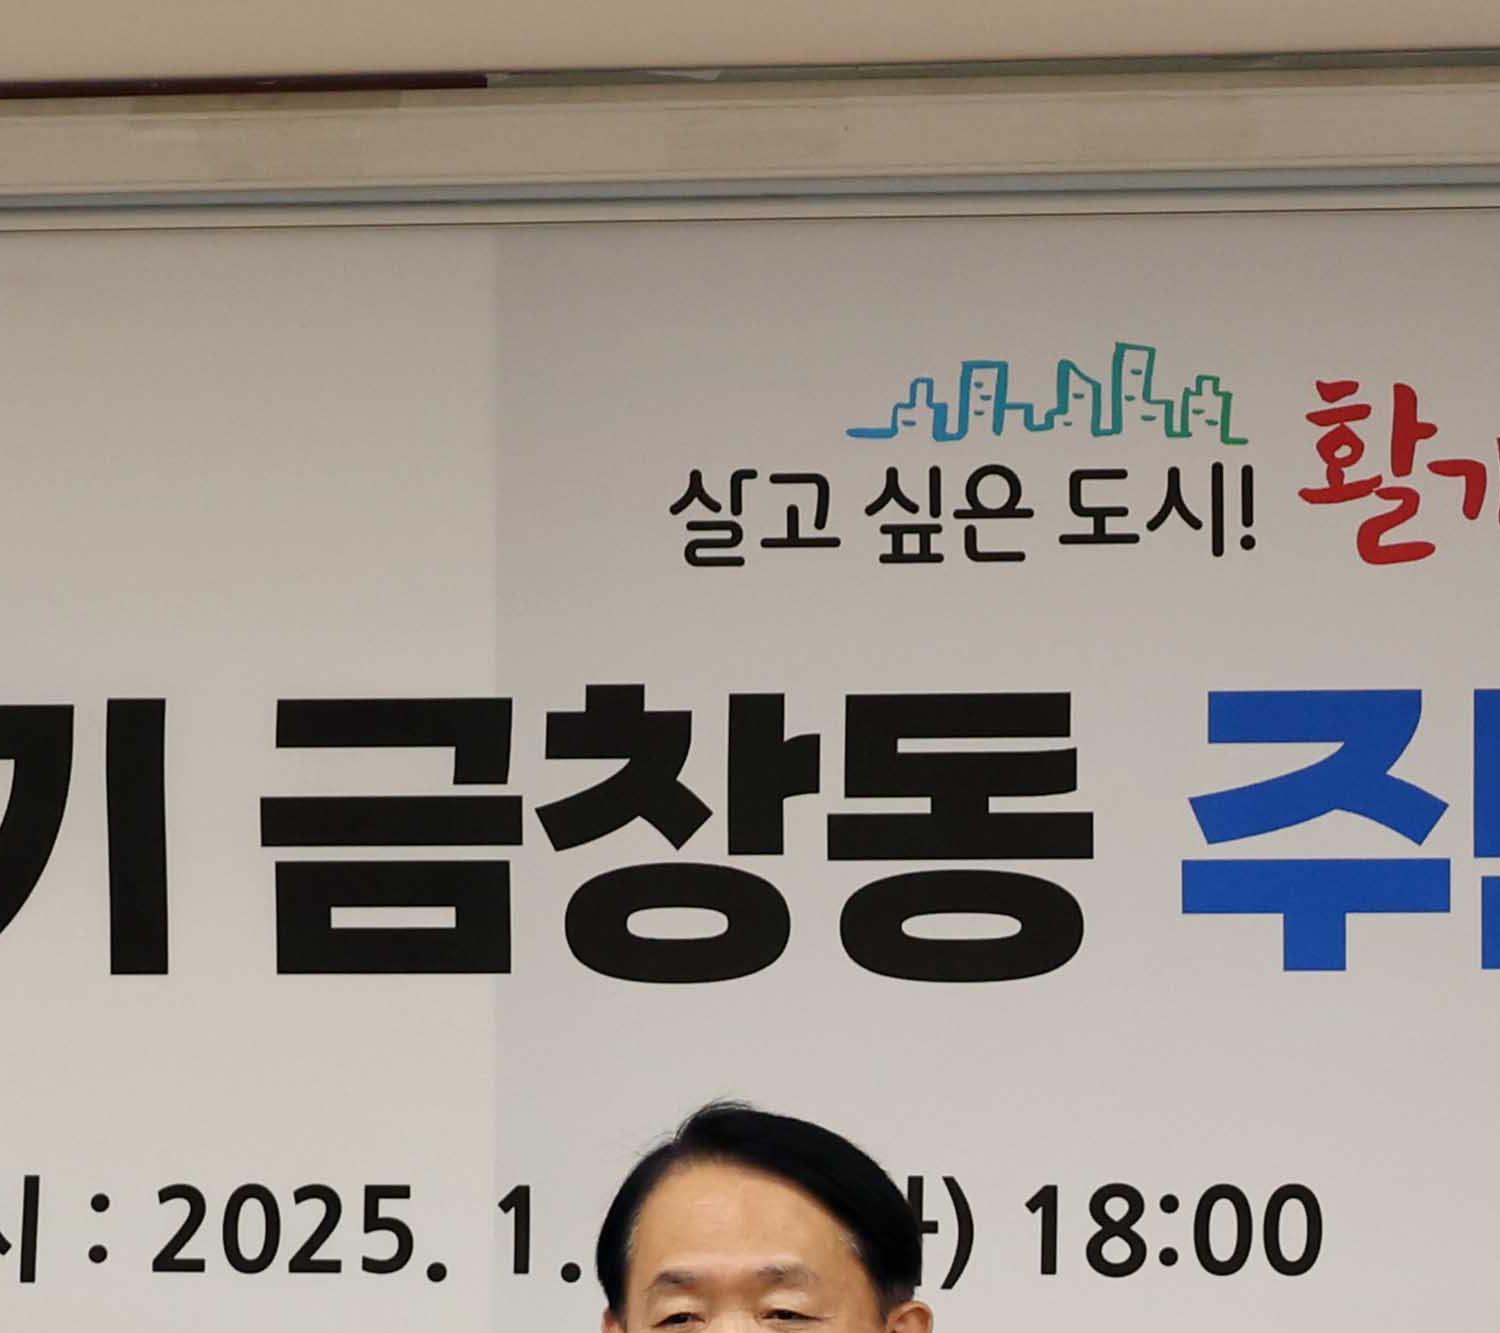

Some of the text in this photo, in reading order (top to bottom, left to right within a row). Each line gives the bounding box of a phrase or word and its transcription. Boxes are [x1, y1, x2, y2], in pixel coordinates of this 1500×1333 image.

[668, 466, 842, 568] 살고
[863, 461, 1035, 565] 싶은
[1058, 460, 1257, 558] 도시!
[260, 684, 1095, 984] 금창동
[87, 1192, 111, 1264] :
[151, 1182, 448, 1283] 2025.
[497, 1184, 582, 1283] 1.
[1024, 1182, 1324, 1278] 18:00
